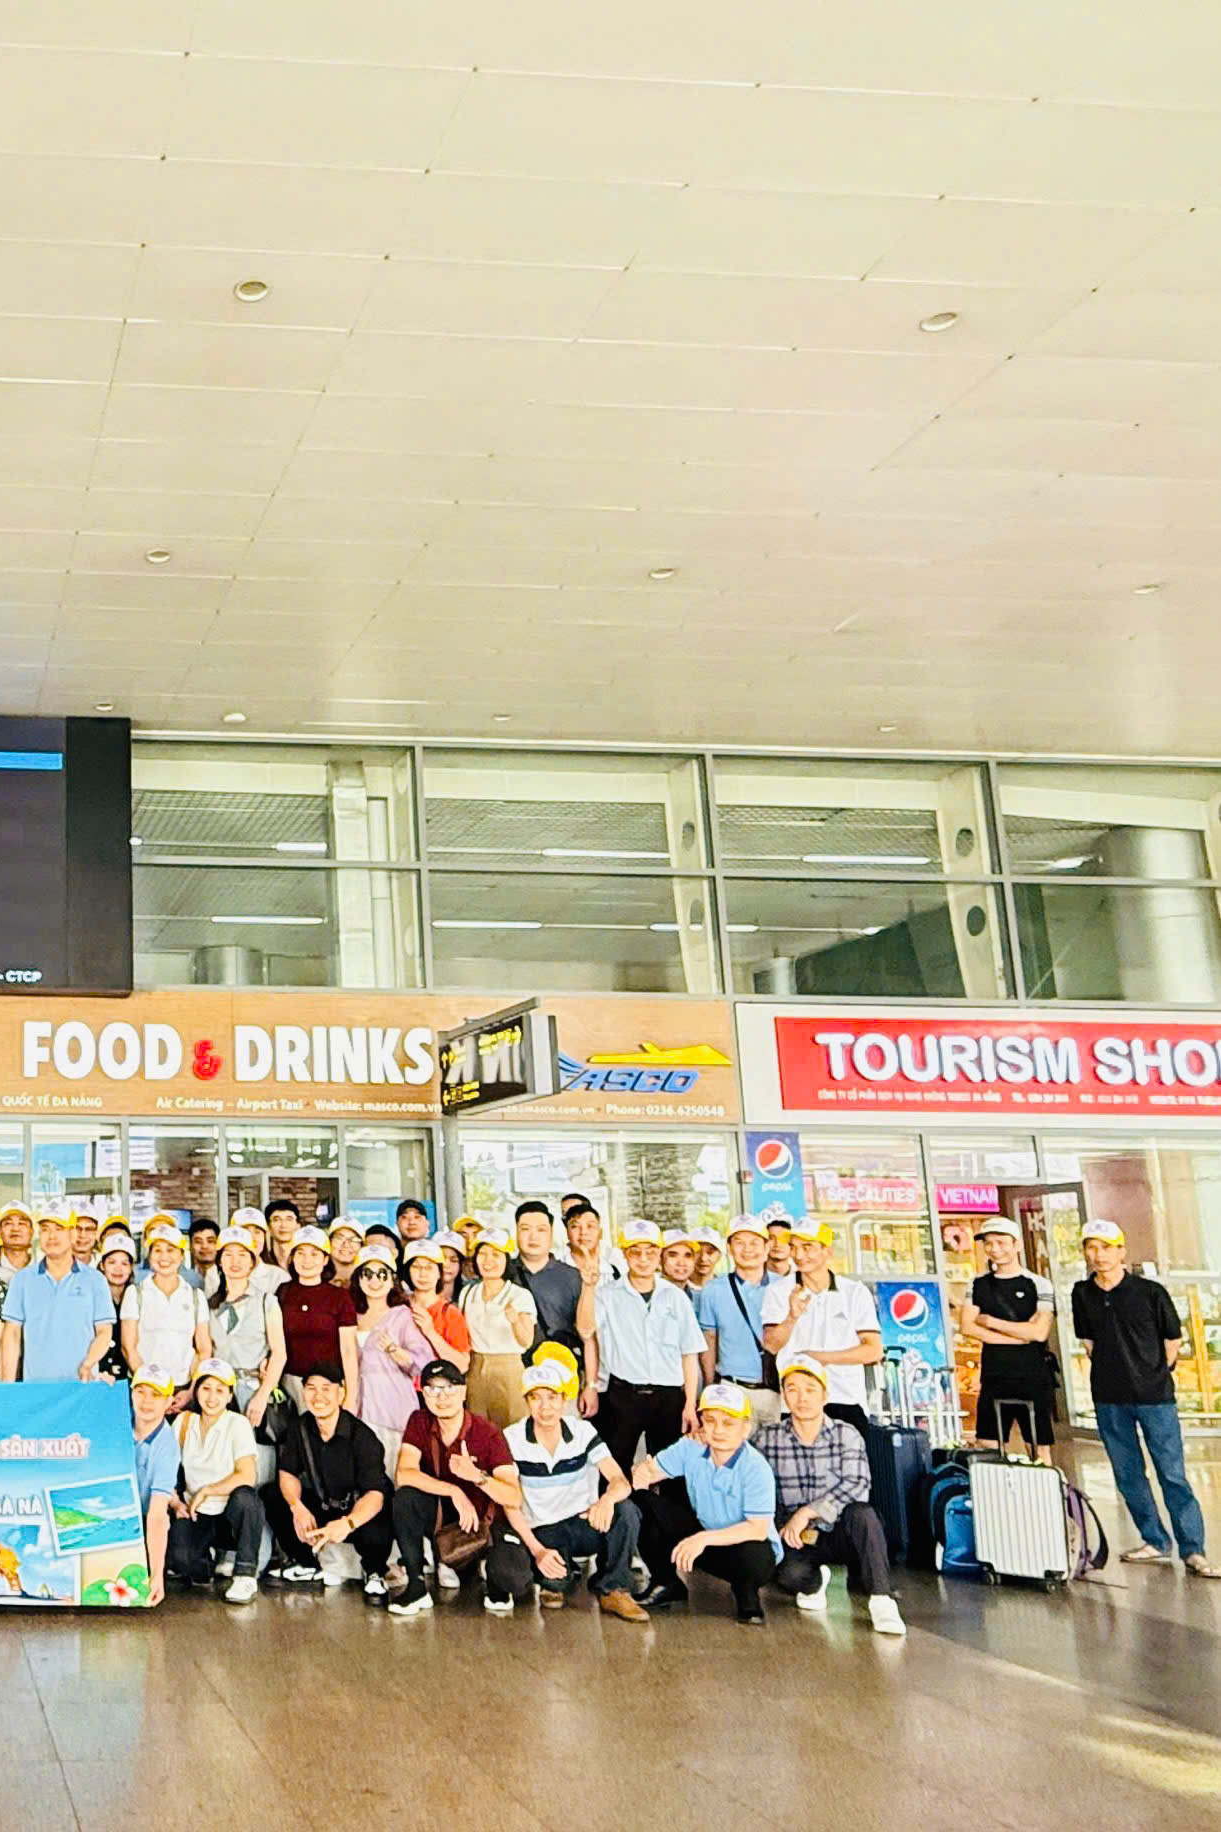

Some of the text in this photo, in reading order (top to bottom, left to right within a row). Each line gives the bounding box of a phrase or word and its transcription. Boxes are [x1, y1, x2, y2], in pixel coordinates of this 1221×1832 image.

[5, 970, 43, 982] CTCP
[22, 1020, 184, 1081] FOOD
[192, 1039, 224, 1081] &
[233, 1023, 436, 1086] DRINKS
[814, 1031, 1221, 1088] TOURISM SHO
[157, 1096, 173, 1109] Air
[175, 1096, 224, 1112] Catering
[237, 1097, 278, 1113] Airport
[279, 1098, 304, 1111] Taxi
[606, 1103, 645, 1116] Phone:
[40, 1432, 91, 1459] XUẤT
[16, 1495, 44, 1517] NÀ
